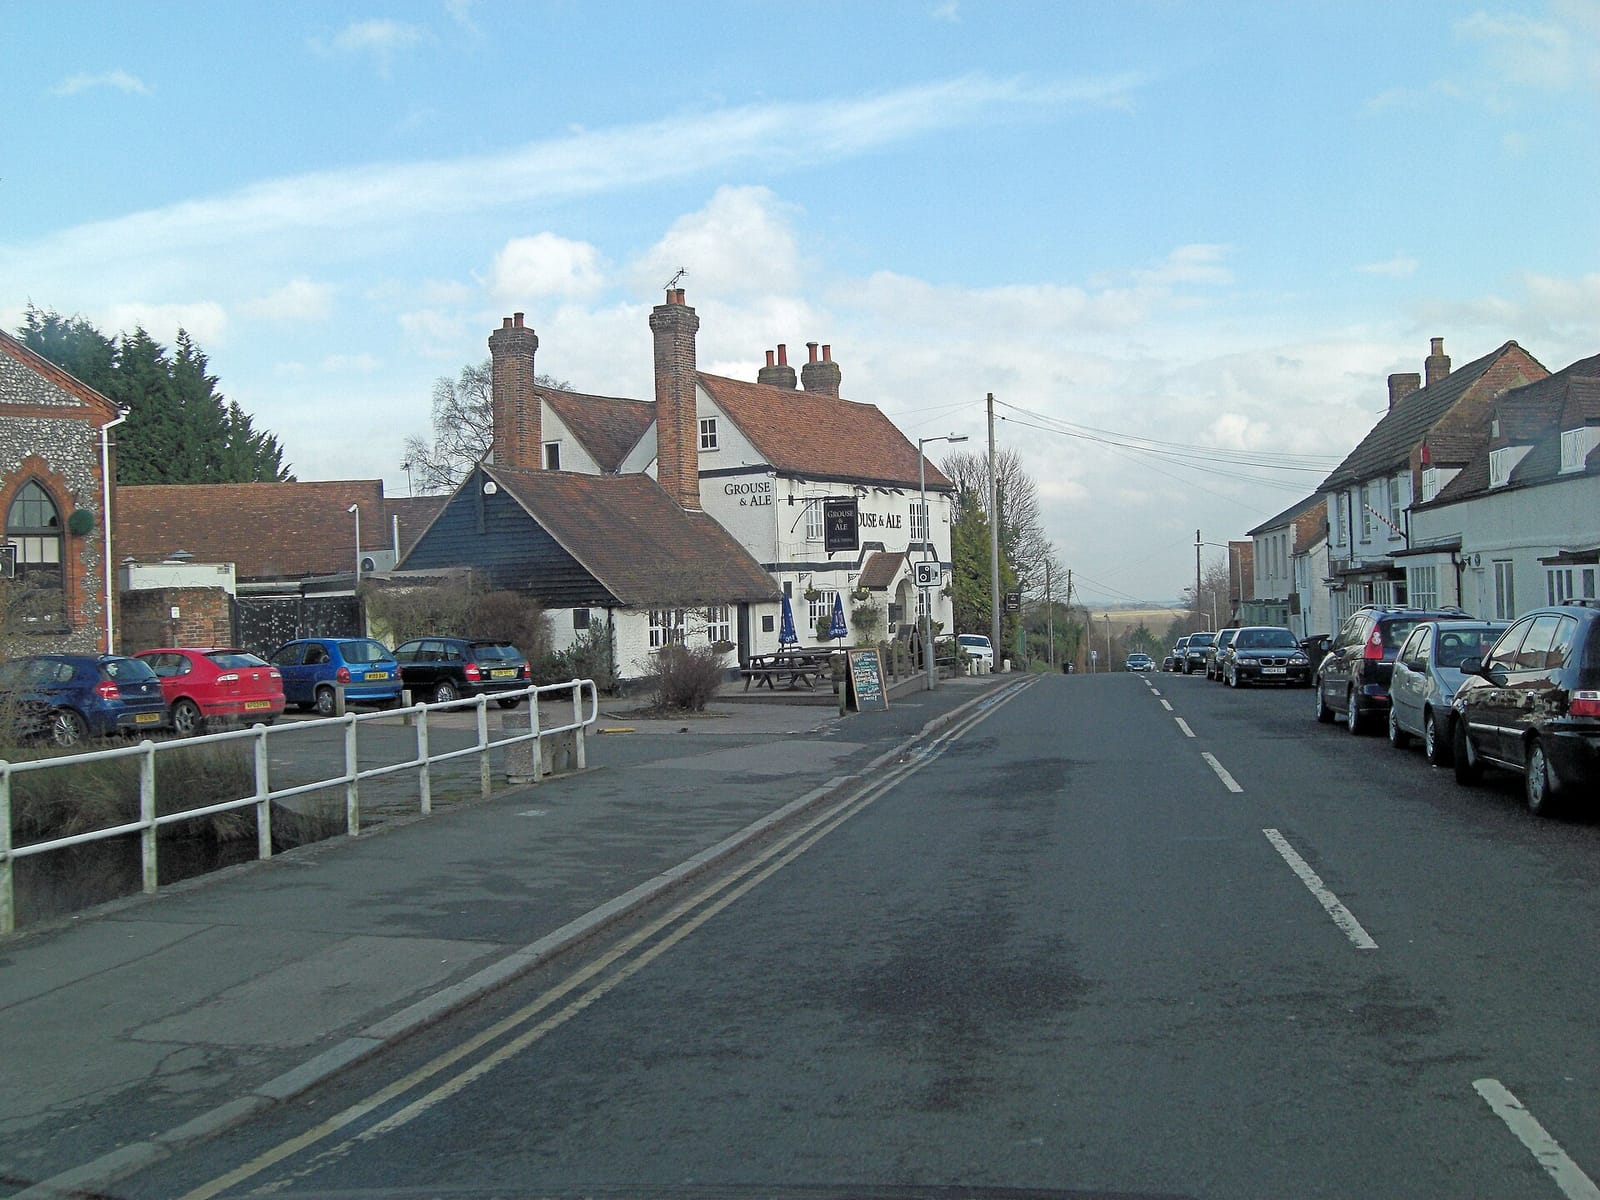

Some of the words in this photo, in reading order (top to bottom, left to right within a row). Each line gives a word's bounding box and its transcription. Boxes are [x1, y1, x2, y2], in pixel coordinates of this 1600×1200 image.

[724, 482, 771, 495] GROUSE
[739, 498, 748, 506] &
[750, 495, 772, 506] ALE
[827, 510, 854, 518] GROUSE
[858, 512, 877, 527] OUSE
[879, 515, 884, 526] &
[886, 512, 901, 528] ALE
[835, 523, 848, 531] ALE
